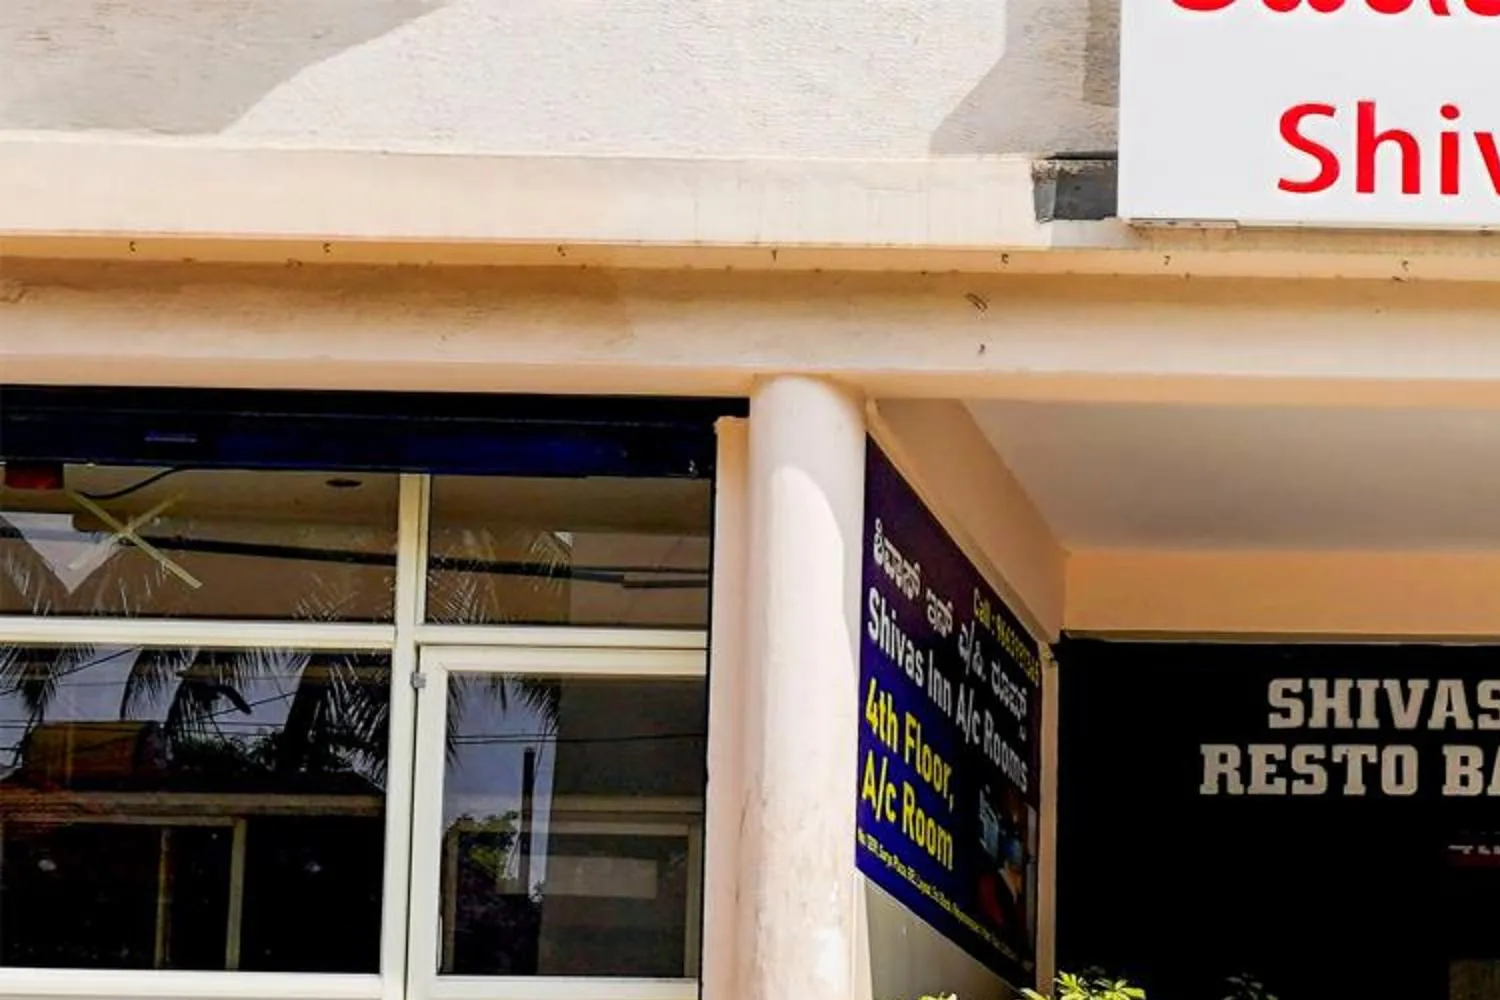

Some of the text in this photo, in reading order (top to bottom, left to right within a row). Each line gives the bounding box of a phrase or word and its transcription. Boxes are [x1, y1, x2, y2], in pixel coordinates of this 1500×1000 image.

[865, 676, 956, 812] 4th Floor,
[867, 585, 924, 688] Shivas
[927, 648, 953, 719] Inn
[956, 690, 981, 745] A/c
[984, 718, 1029, 793] Rooms
[861, 748, 954, 872] A/c Room
[1199, 744, 1419, 797] RESTO
